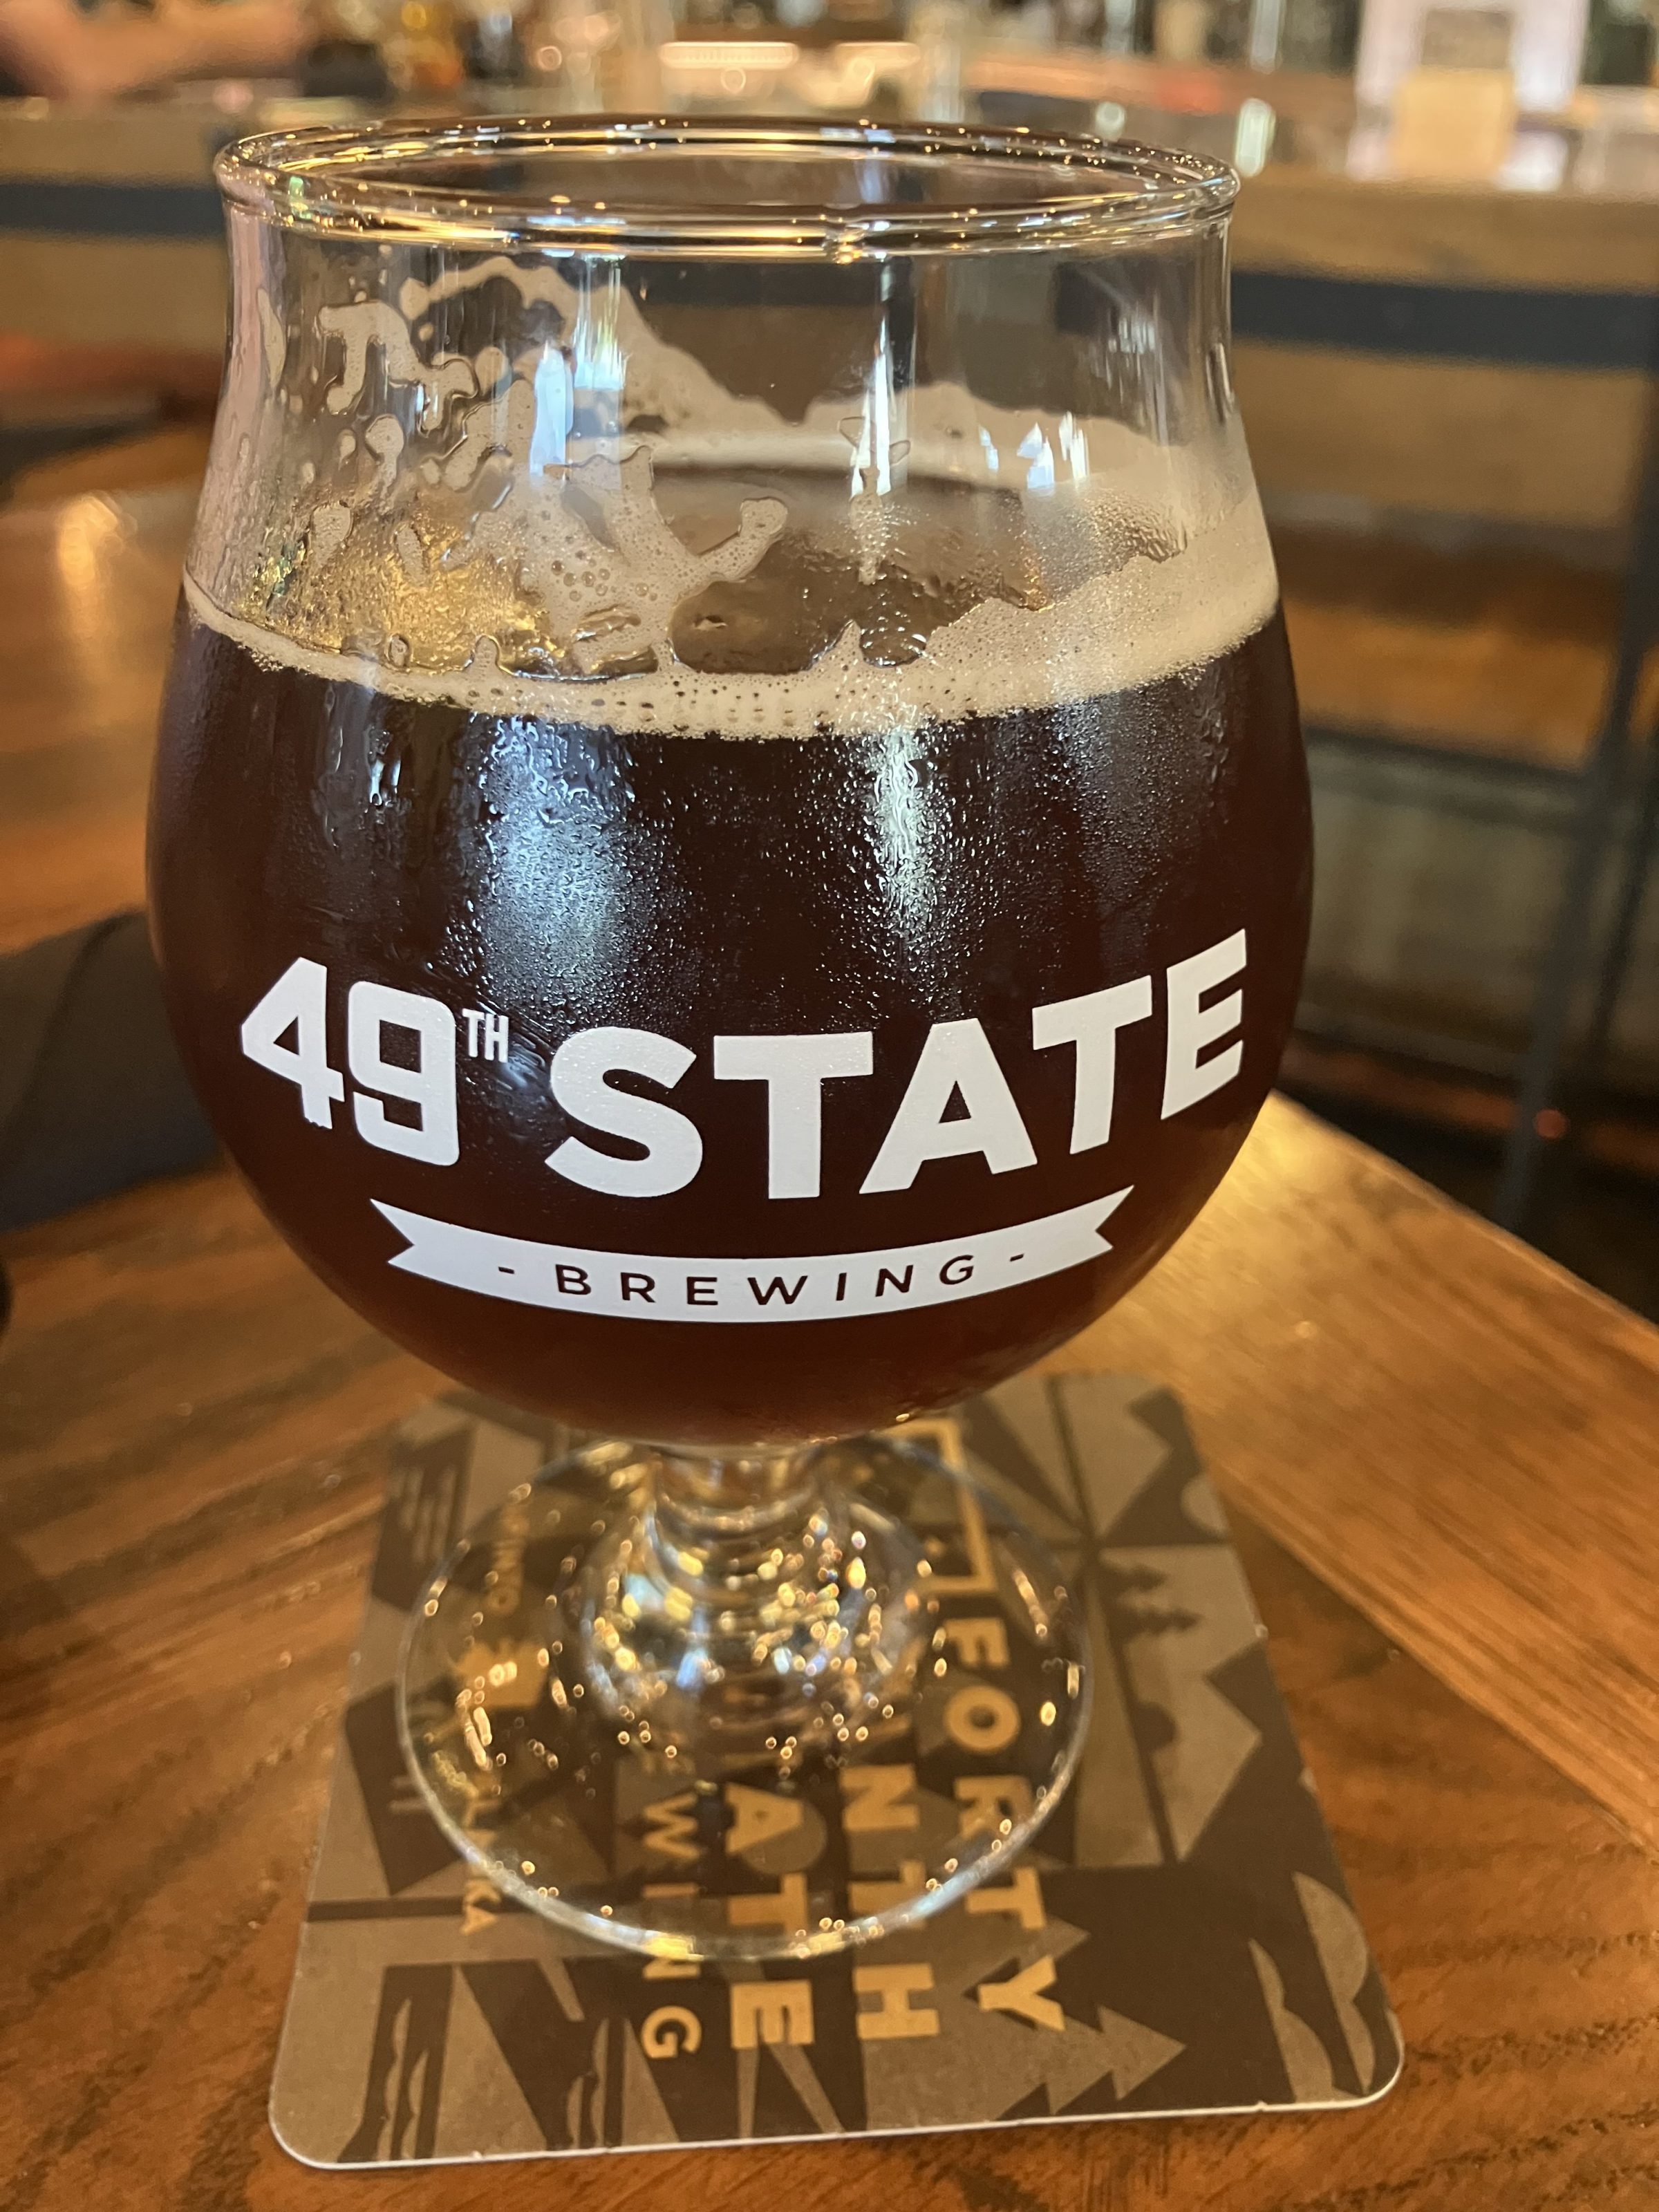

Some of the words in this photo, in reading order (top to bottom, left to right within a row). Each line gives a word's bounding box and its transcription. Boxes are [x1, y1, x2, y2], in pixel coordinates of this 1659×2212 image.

[544, 928, 1246, 1200] STATE
[554, 1255, 975, 1306] BREWING
[723, 1735, 815, 2050] ATE
[943, 1617, 1066, 2032] FORTY
